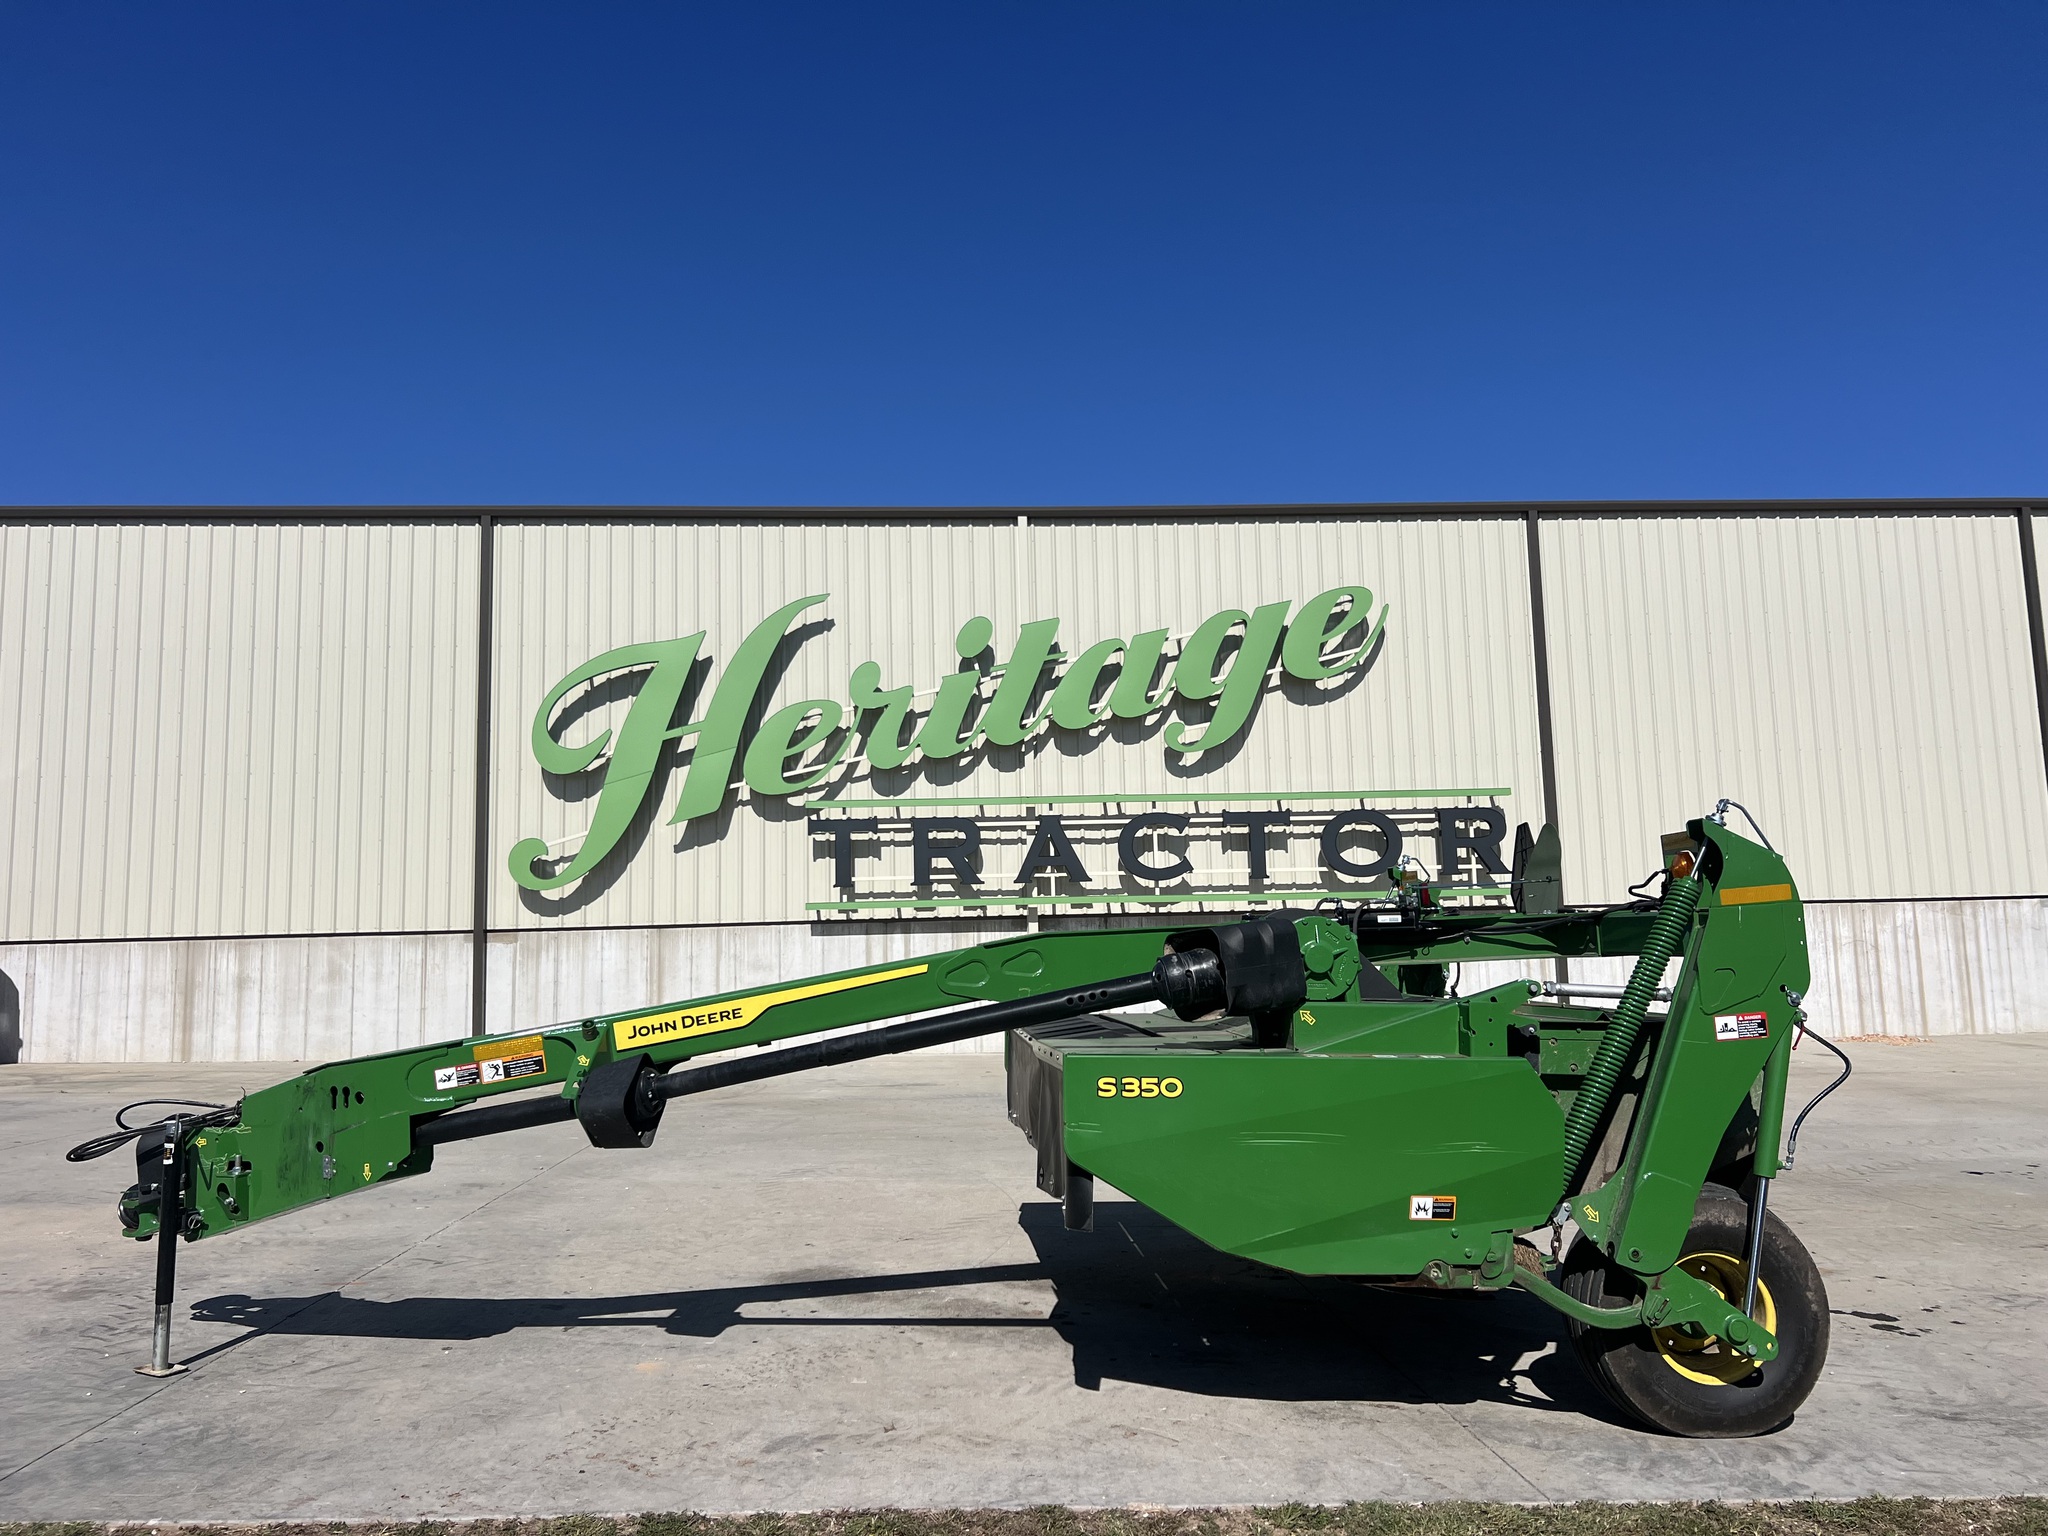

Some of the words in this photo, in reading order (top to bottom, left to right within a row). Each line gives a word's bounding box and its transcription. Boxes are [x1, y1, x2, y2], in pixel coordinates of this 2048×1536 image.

[508, 585, 1389, 891] Heritage
[808, 806, 1512, 888] TRACTOR
[628, 1020, 677, 1039] JOHN
[681, 1008, 743, 1029] DEERE
[1097, 1076, 1118, 1098] S
[1121, 1076, 1184, 1098] 350
